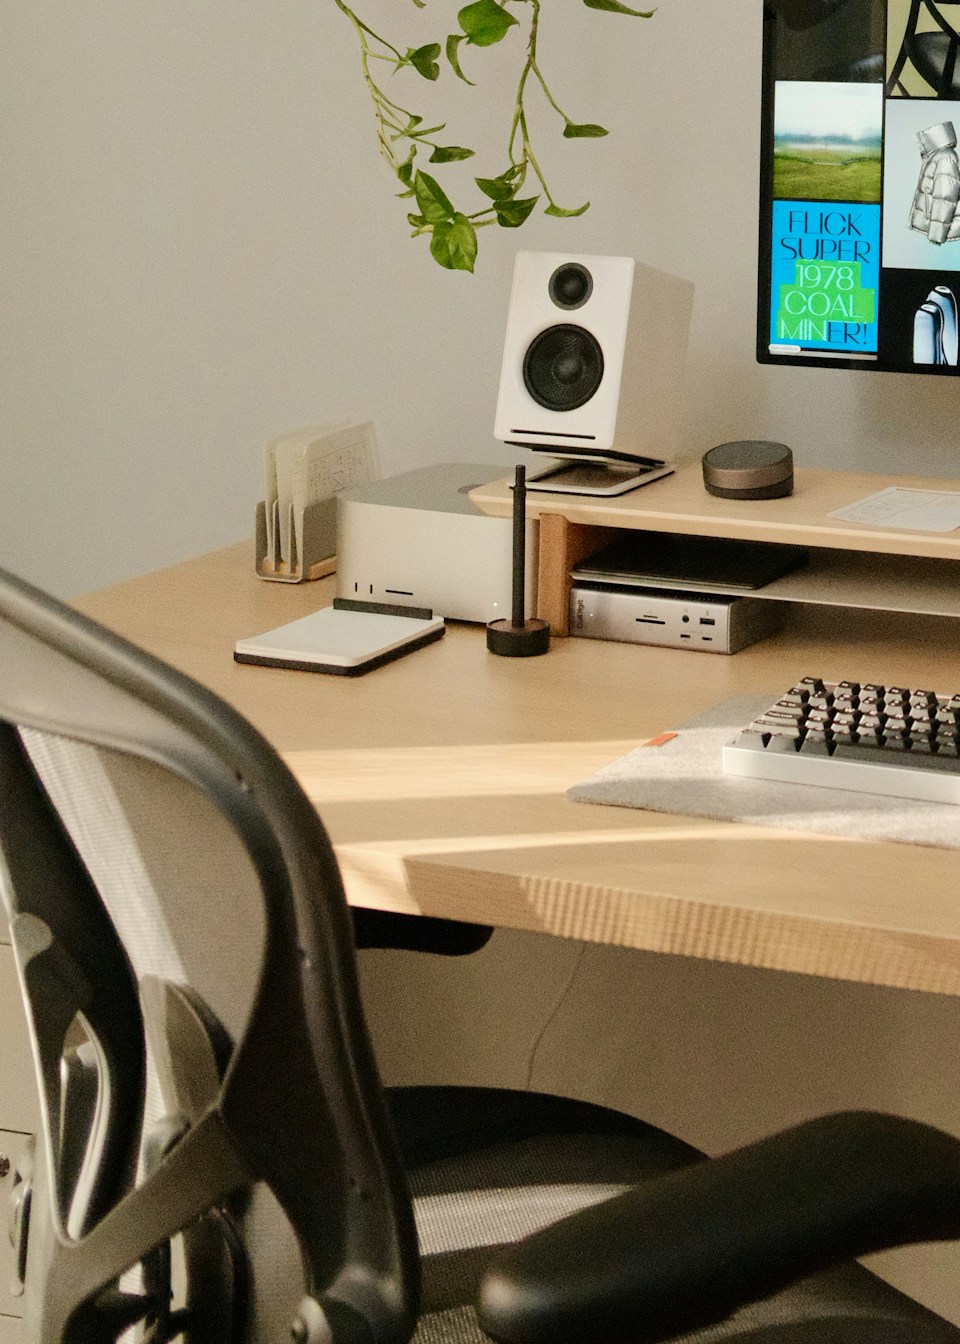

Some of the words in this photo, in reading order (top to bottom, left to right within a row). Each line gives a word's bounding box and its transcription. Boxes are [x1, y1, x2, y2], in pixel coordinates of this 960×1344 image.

[789, 210, 863, 236] FLICK
[780, 237, 871, 263] SUPER
[796, 264, 855, 291] 1978
[784, 290, 865, 318] COAL
[780, 318, 868, 345] MINER!
